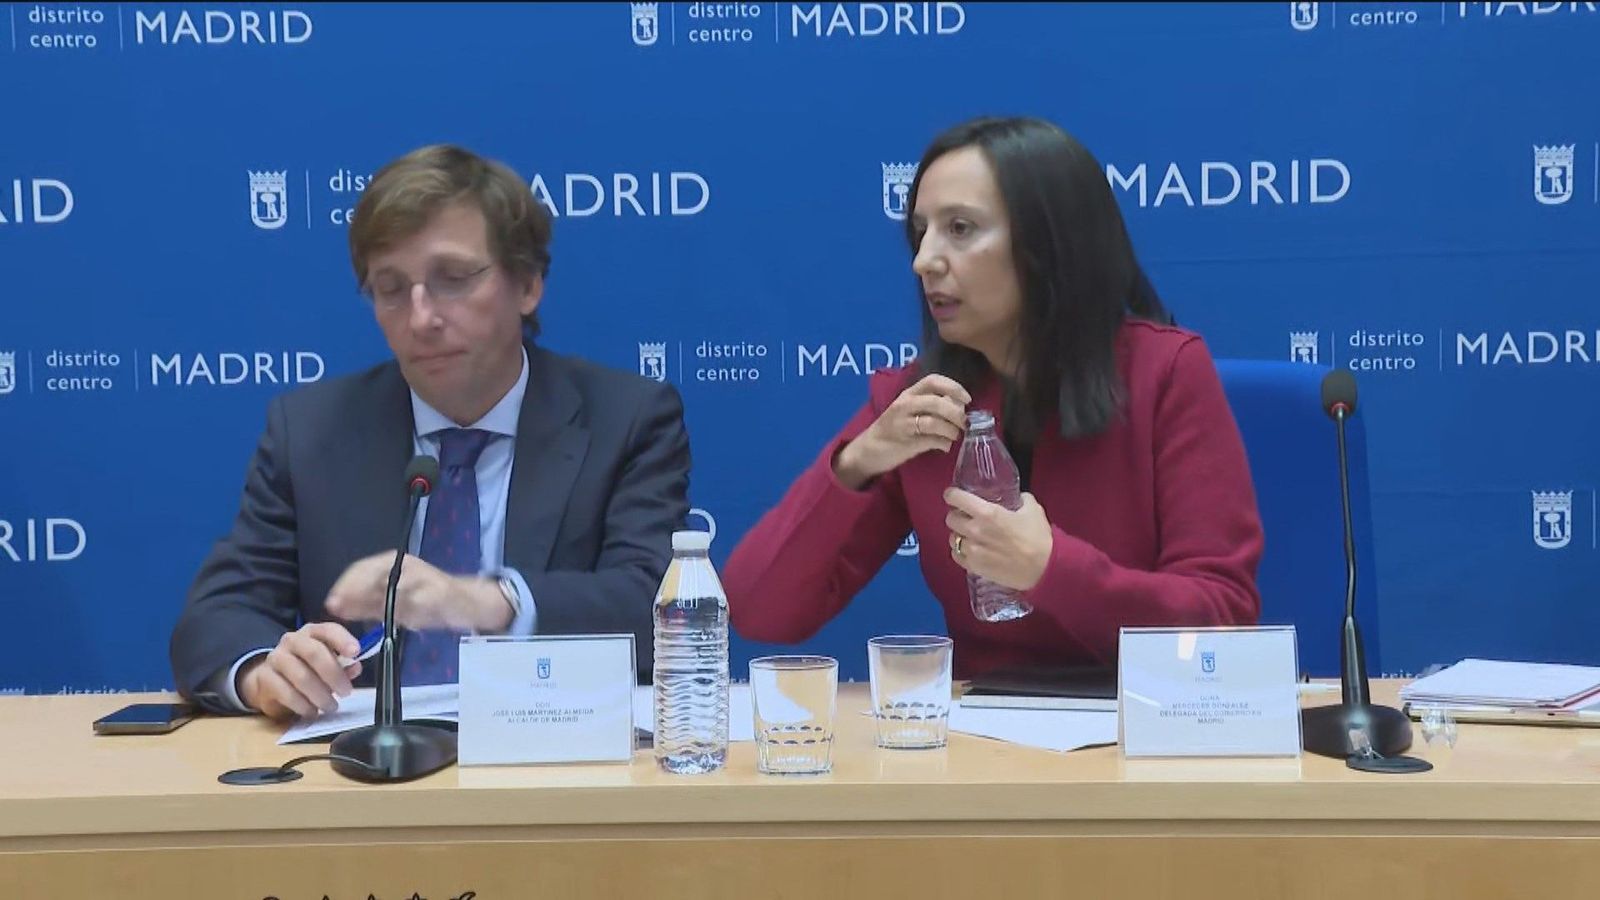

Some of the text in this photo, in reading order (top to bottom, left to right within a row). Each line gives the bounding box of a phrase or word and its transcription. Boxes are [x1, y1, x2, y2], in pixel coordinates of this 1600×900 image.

[28, 4, 104, 23] distrito
[688, 2, 761, 18] distrito
[1350, 10, 1418, 26] centro
[134, 10, 314, 44] MADRID
[791, 2, 966, 37] MADRID
[30, 34, 97, 48] centro
[688, 28, 753, 42] centro
[1106, 159, 1351, 207] MADRID
[529, 171, 710, 218] ADRID
[1349, 330, 1424, 347] distrito
[696, 341, 767, 358] distrito
[46, 350, 120, 367] distrito
[798, 343, 919, 377] MADR
[1349, 356, 1416, 371] centro
[151, 351, 325, 385] MADRID
[696, 367, 760, 381] centro
[47, 376, 113, 390] centro
